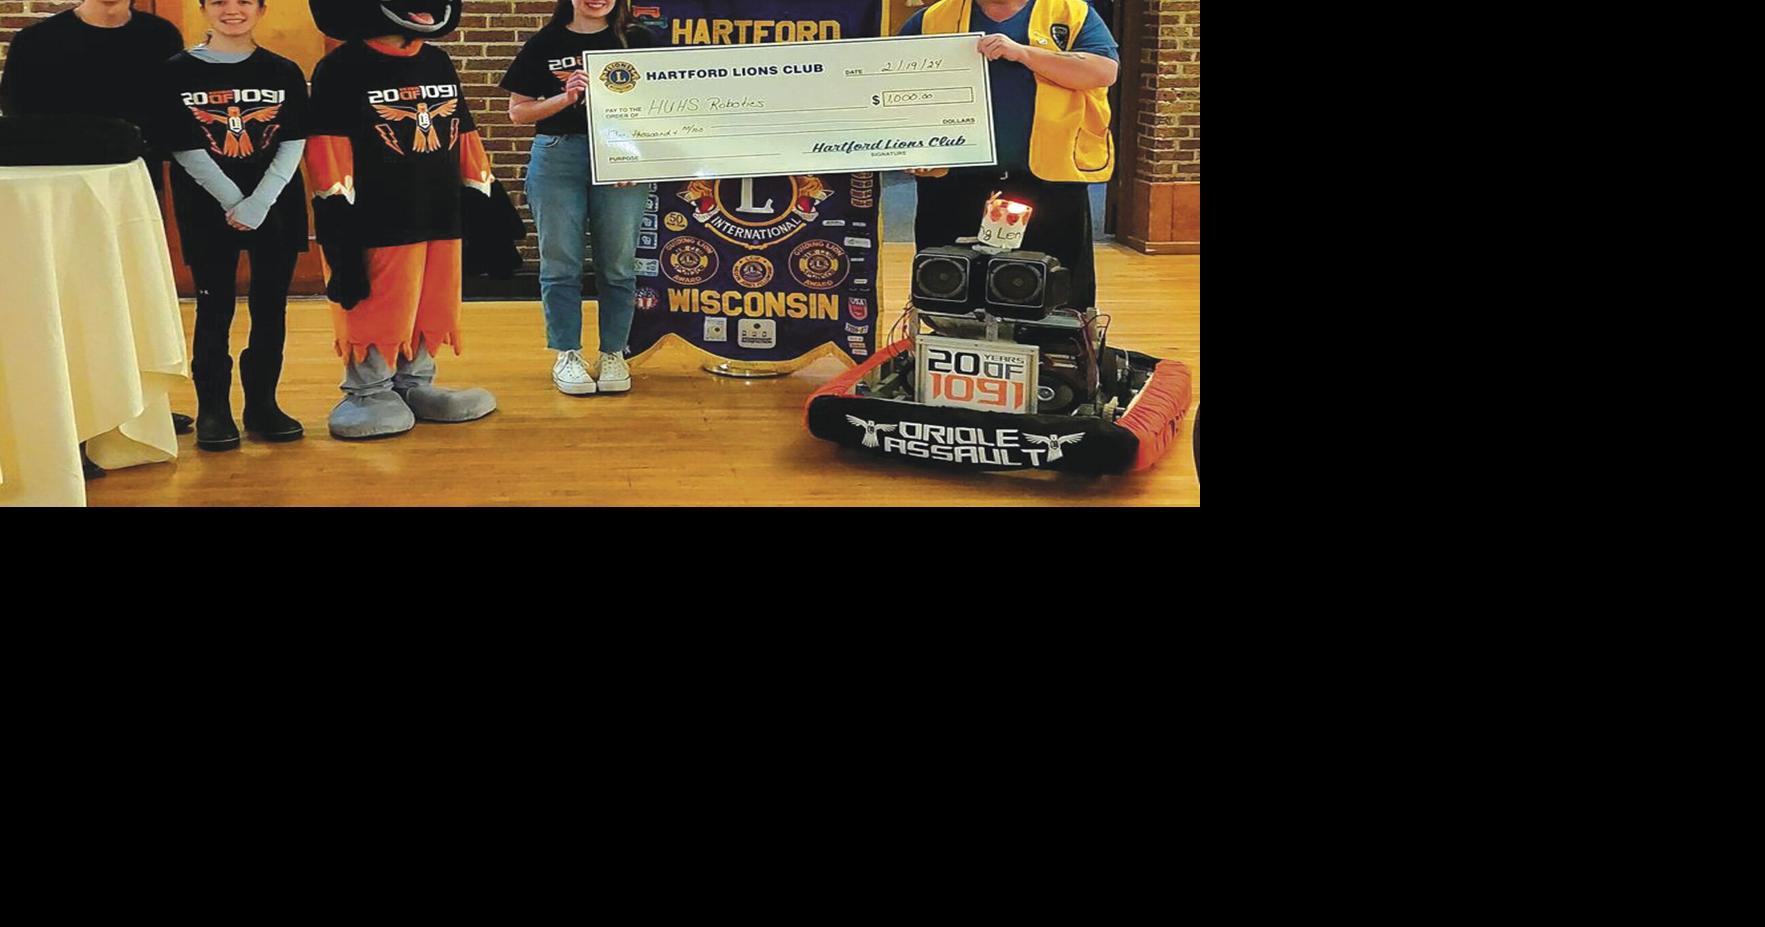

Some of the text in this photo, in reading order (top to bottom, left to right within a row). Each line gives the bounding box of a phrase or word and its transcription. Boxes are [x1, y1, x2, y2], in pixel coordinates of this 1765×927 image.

[671, 18, 841, 45] HARTFORD
[548, 56, 577, 71] 20
[646, 63, 824, 81] HARTFORD LIONS CLUB
[181, 92, 209, 106] 20
[231, 88, 286, 104] 1091
[367, 88, 400, 104] 20
[418, 84, 458, 99] 1091
[872, 95, 881, 106] $
[812, 135, 966, 154] Hartford Lions Club
[710, 214, 802, 240] INTERNATIONAL
[667, 287, 840, 321] WISCONSIN
[928, 348, 1025, 376] 20 YEARS
[983, 361, 1025, 380] OF
[929, 373, 1025, 410] 1091
[899, 421, 1020, 448] ORIOLE
[884, 436, 1048, 467] ASSAULT
